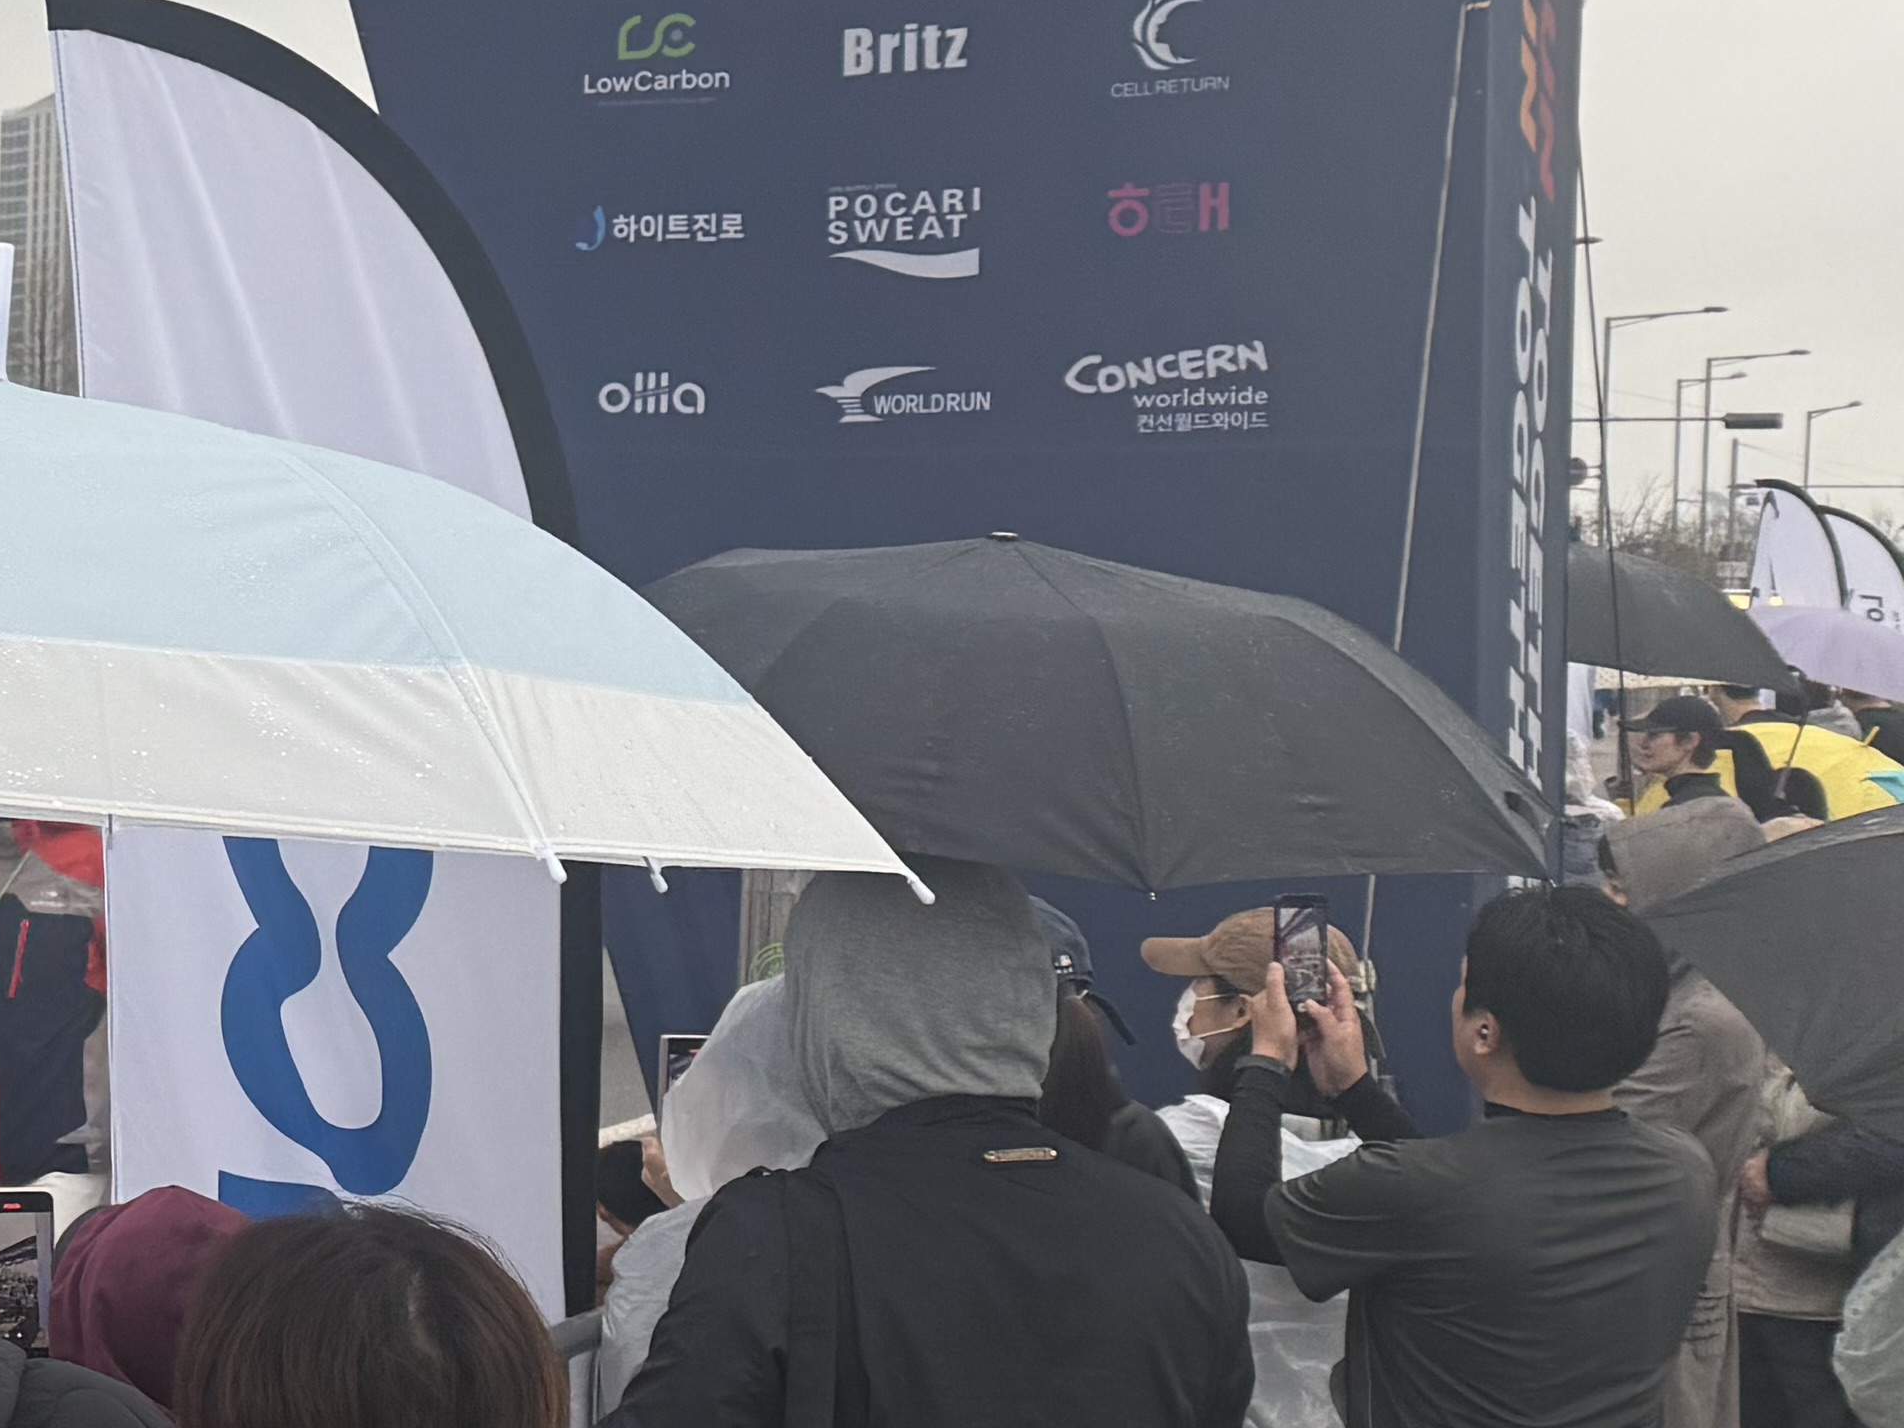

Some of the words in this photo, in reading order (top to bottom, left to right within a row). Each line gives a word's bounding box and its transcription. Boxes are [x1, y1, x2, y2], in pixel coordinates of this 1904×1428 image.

[842, 23, 968, 77] Britz
[583, 69, 731, 94] LowCarbon
[828, 187, 982, 220] POCARI
[612, 213, 745, 243] 하이트진로
[827, 214, 969, 246] SWEAT
[873, 391, 991, 415] WORLDRUN
[1133, 386, 1270, 409] worldwide
[1508, 195, 1536, 771] TOGETH
[1527, 247, 1553, 793] TOGETH
